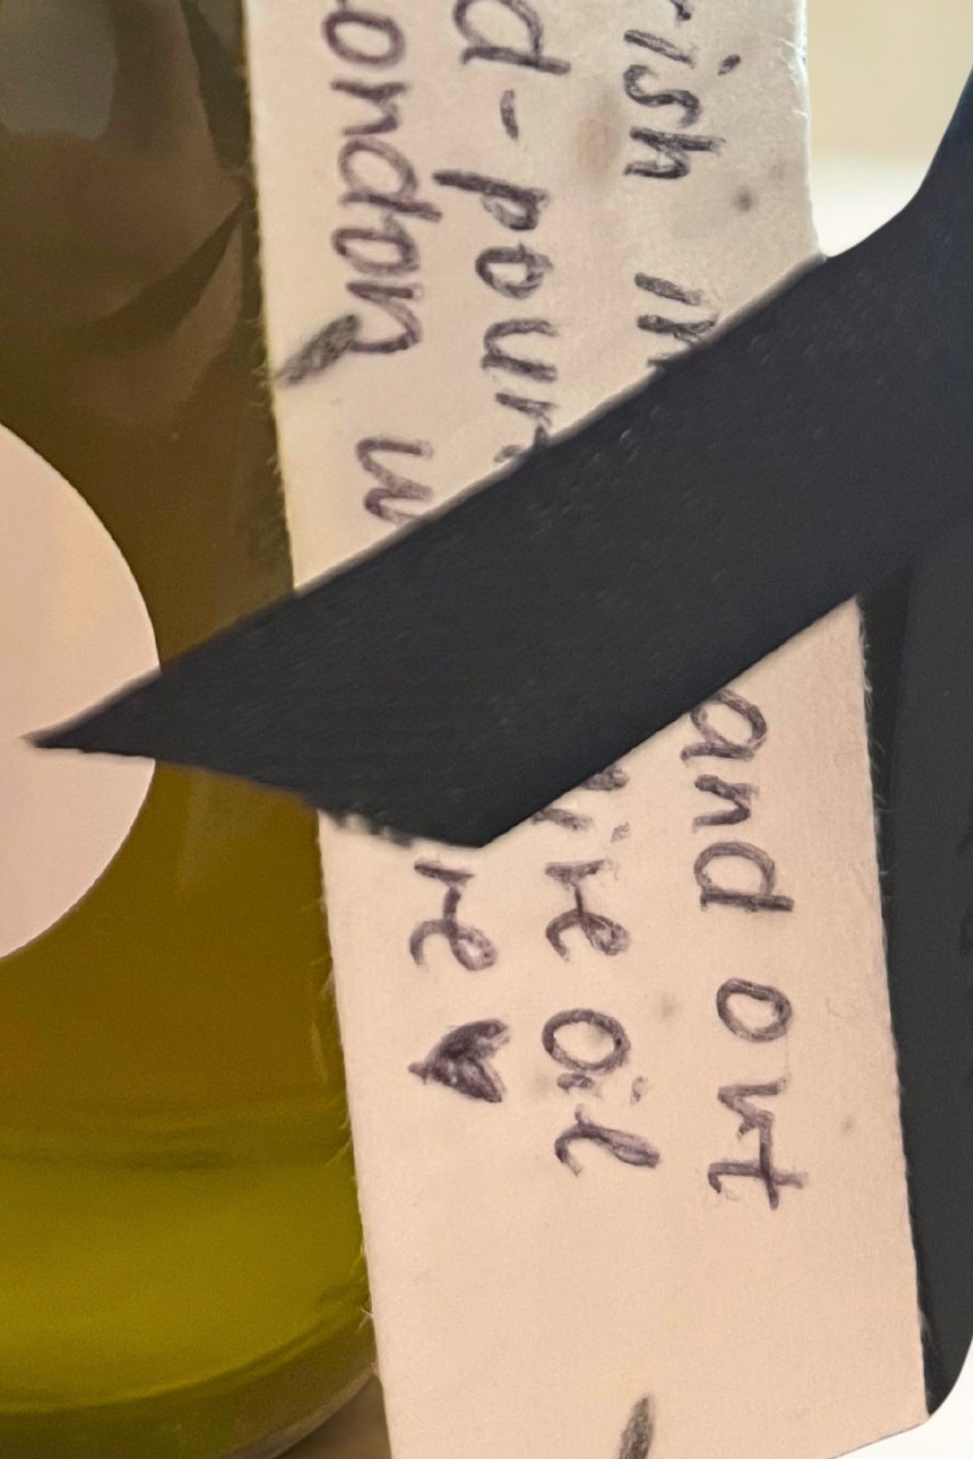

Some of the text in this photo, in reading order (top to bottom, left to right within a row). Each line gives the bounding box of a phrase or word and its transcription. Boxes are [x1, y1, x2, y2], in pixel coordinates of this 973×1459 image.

[679, 687, 795, 914] and
[541, 1007, 662, 1178] oil
[708, 977, 809, 1211] out
